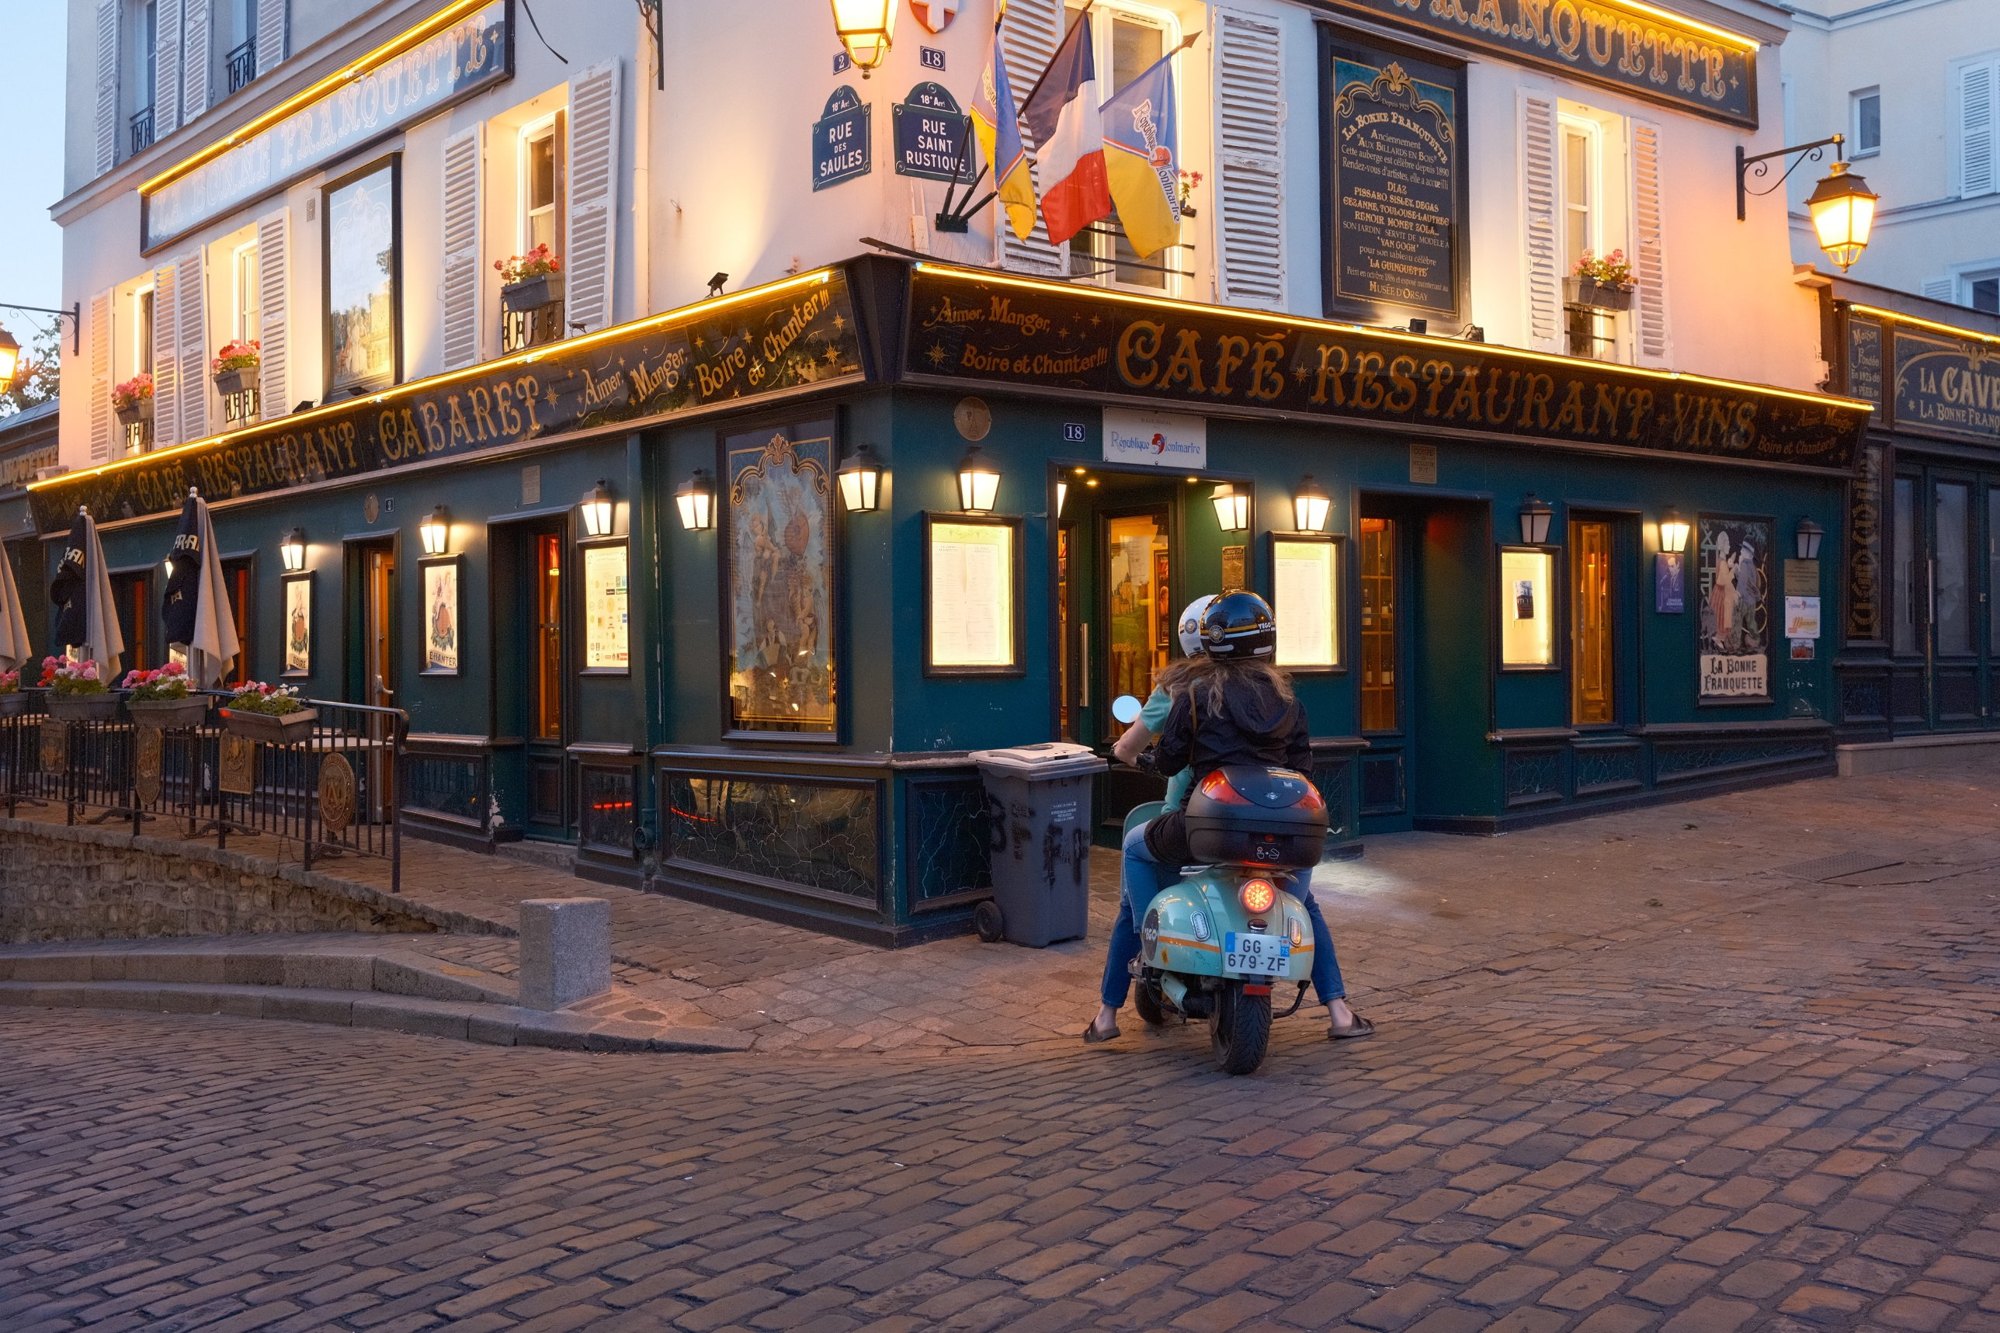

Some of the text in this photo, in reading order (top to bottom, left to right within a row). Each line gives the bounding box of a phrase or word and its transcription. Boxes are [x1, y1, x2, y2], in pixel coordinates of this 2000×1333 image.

[838, 55, 845, 69] 2
[925, 51, 941, 66] 18
[280, 14, 488, 168] FRANQUETTE
[829, 121, 853, 144] RUE
[922, 119, 947, 136] RUE
[1342, 111, 1448, 164] LA BONNE FRANQUETTE
[834, 142, 847, 154] DES
[918, 135, 953, 153] SAINT
[1371, 129, 1421, 149] Anciennement
[820, 149, 863, 178] SAULES
[906, 150, 966, 172] RUSTIQUE
[1341, 144, 1358, 157] Cette
[1358, 151, 1383, 164] auberge
[1384, 157, 1393, 165] est
[1415, 162, 1435, 175] depuis
[1415, 200, 1439, 213] DEGAS
[1343, 222, 1357, 231] SON
[1852, 328, 1877, 346] Maison
[961, 343, 1010, 374] Boire
[1012, 355, 1031, 375] et
[695, 346, 747, 397] Boire
[748, 356, 766, 386] et
[1116, 319, 1758, 449] CAFÉ RESTAURANT VINS
[1920, 366, 2000, 411] LA CAVE
[1920, 400, 1934, 418] LA
[1937, 402, 1967, 423] BONNE
[198, 420, 358, 500] RESTAURANT
[379, 375, 541, 460] CABARET
[1067, 425, 1082, 440] 18
[1710, 656, 1757, 675] LA BONNE
[1704, 674, 1763, 692] FRANQUETTE
